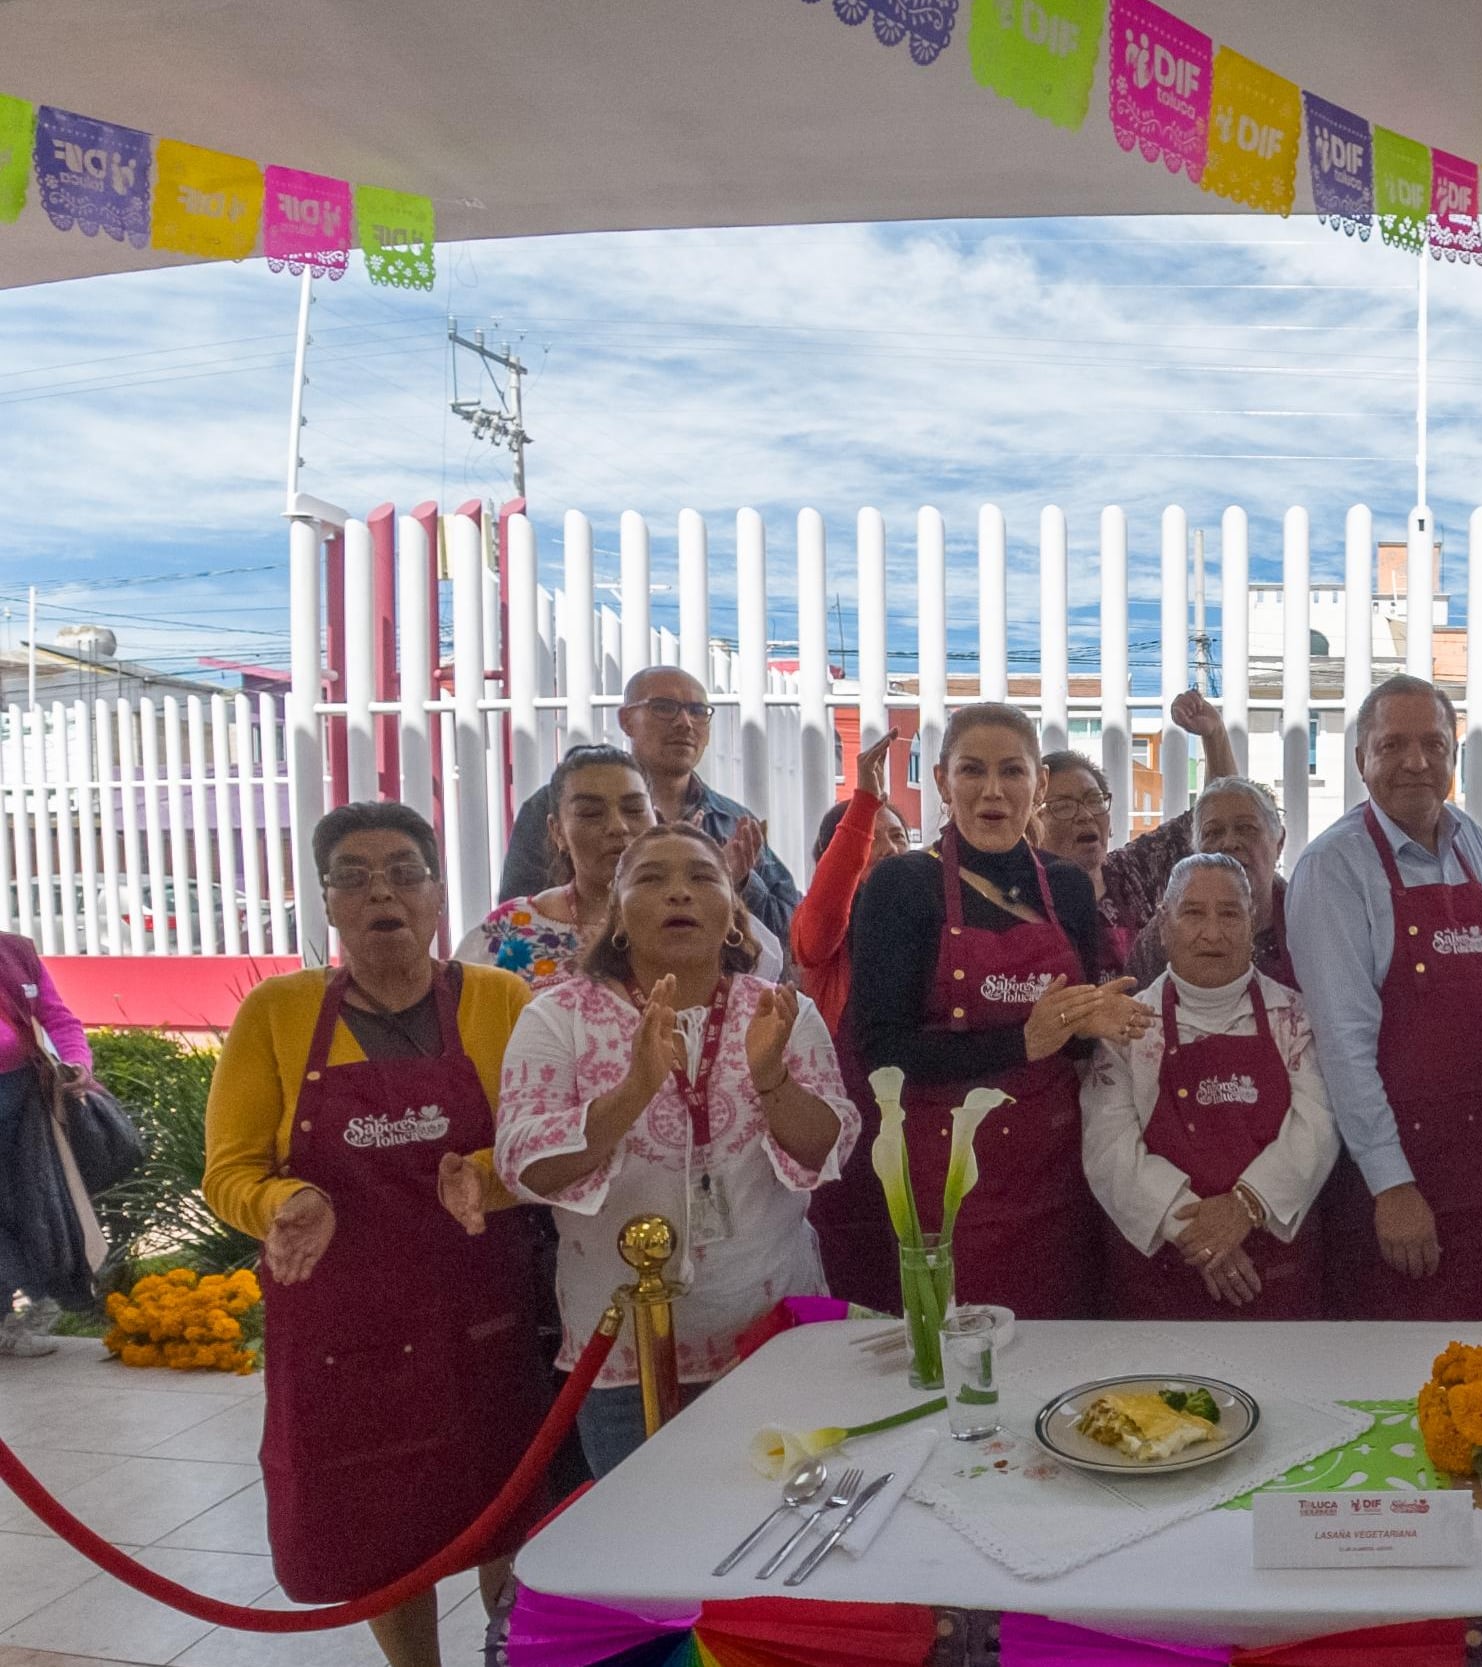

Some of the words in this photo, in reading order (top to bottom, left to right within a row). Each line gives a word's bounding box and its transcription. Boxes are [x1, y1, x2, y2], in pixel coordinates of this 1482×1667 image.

[1021, 0, 1079, 58] DIF
[1154, 43, 1201, 98] DIF
[1157, 86, 1196, 120] toluca
[1237, 115, 1285, 160] DIF
[1330, 134, 1363, 175] DIF
[1398, 177, 1425, 210] DIF
[1447, 181, 1473, 213] DIF
[980, 974, 1036, 1001] Sabores
[344, 1117, 418, 1147] Sabores
[374, 1129, 423, 1148] Toluca
[1363, 1499, 1381, 1508] DIF
[1314, 1529, 1351, 1540] LASAÑA
[1354, 1528, 1417, 1539] VEGETARIANA
